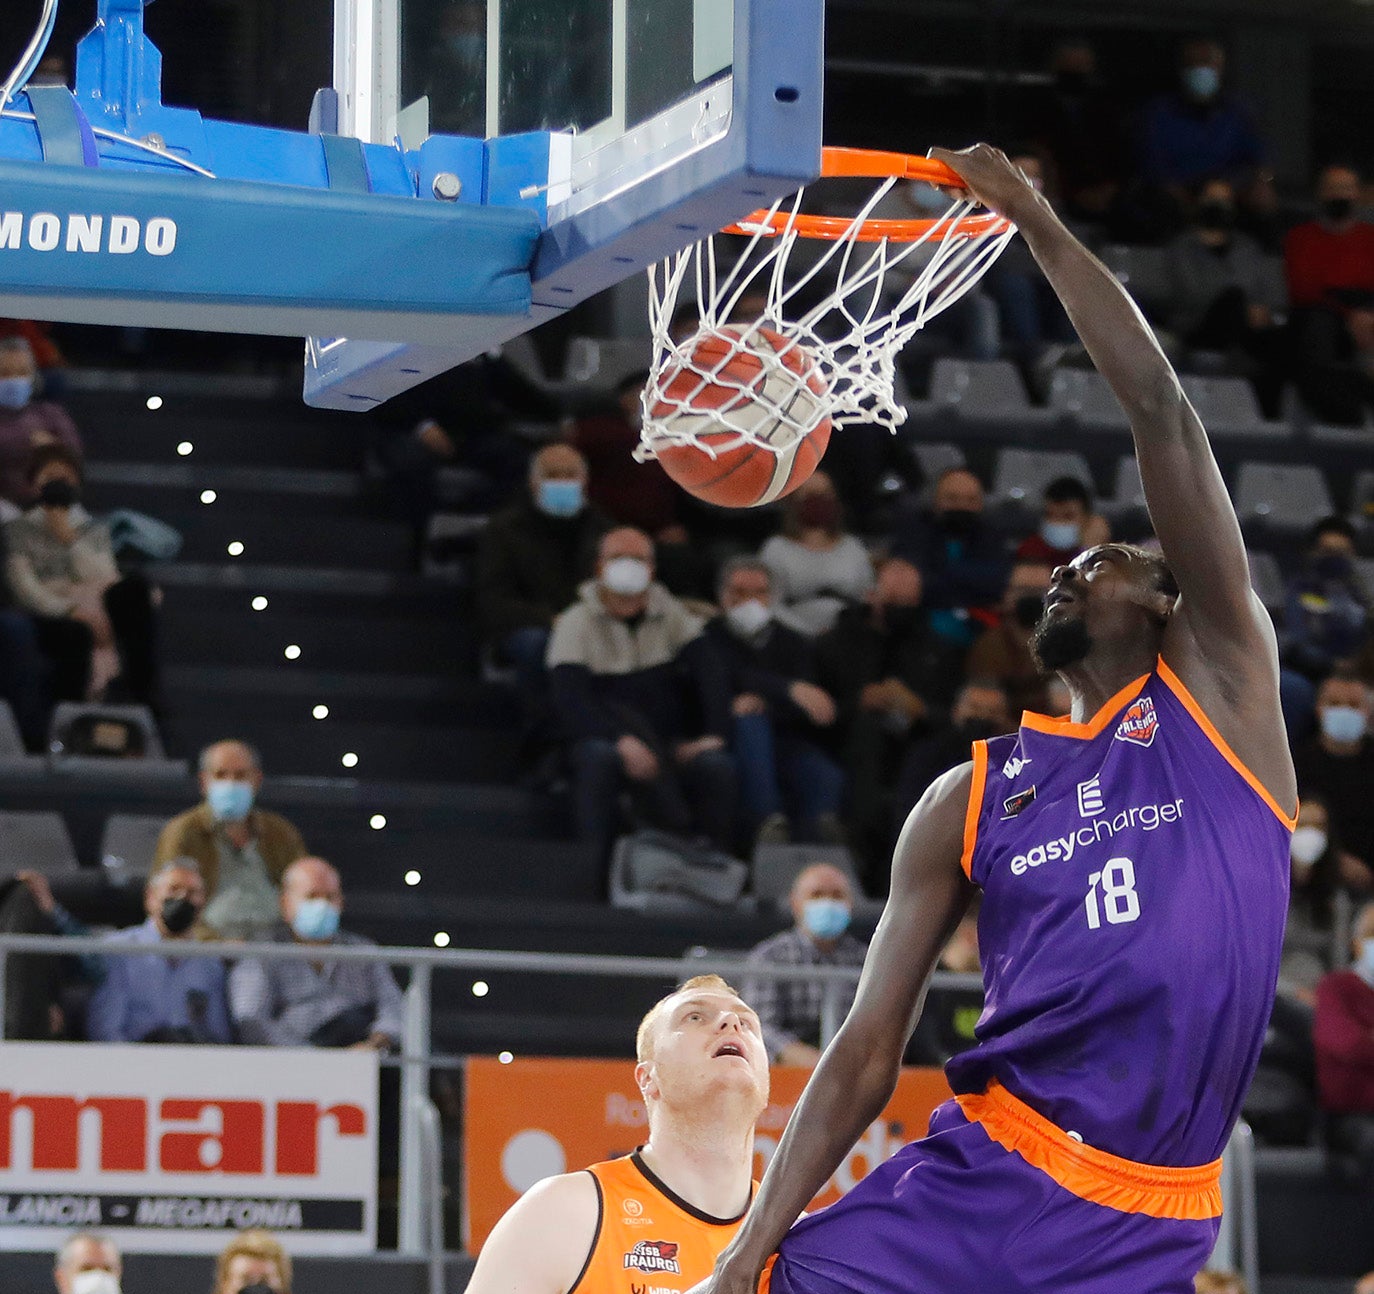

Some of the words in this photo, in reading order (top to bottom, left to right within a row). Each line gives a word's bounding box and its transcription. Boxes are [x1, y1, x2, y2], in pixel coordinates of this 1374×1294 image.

[0, 211, 178, 256] MONDO
[1117, 710, 1158, 735] PALENCI
[1010, 798, 1184, 876] easycharger
[1085, 857, 1142, 930] 18
[623, 1253, 680, 1274] IRAURGI
[640, 1246, 660, 1257] ISB
